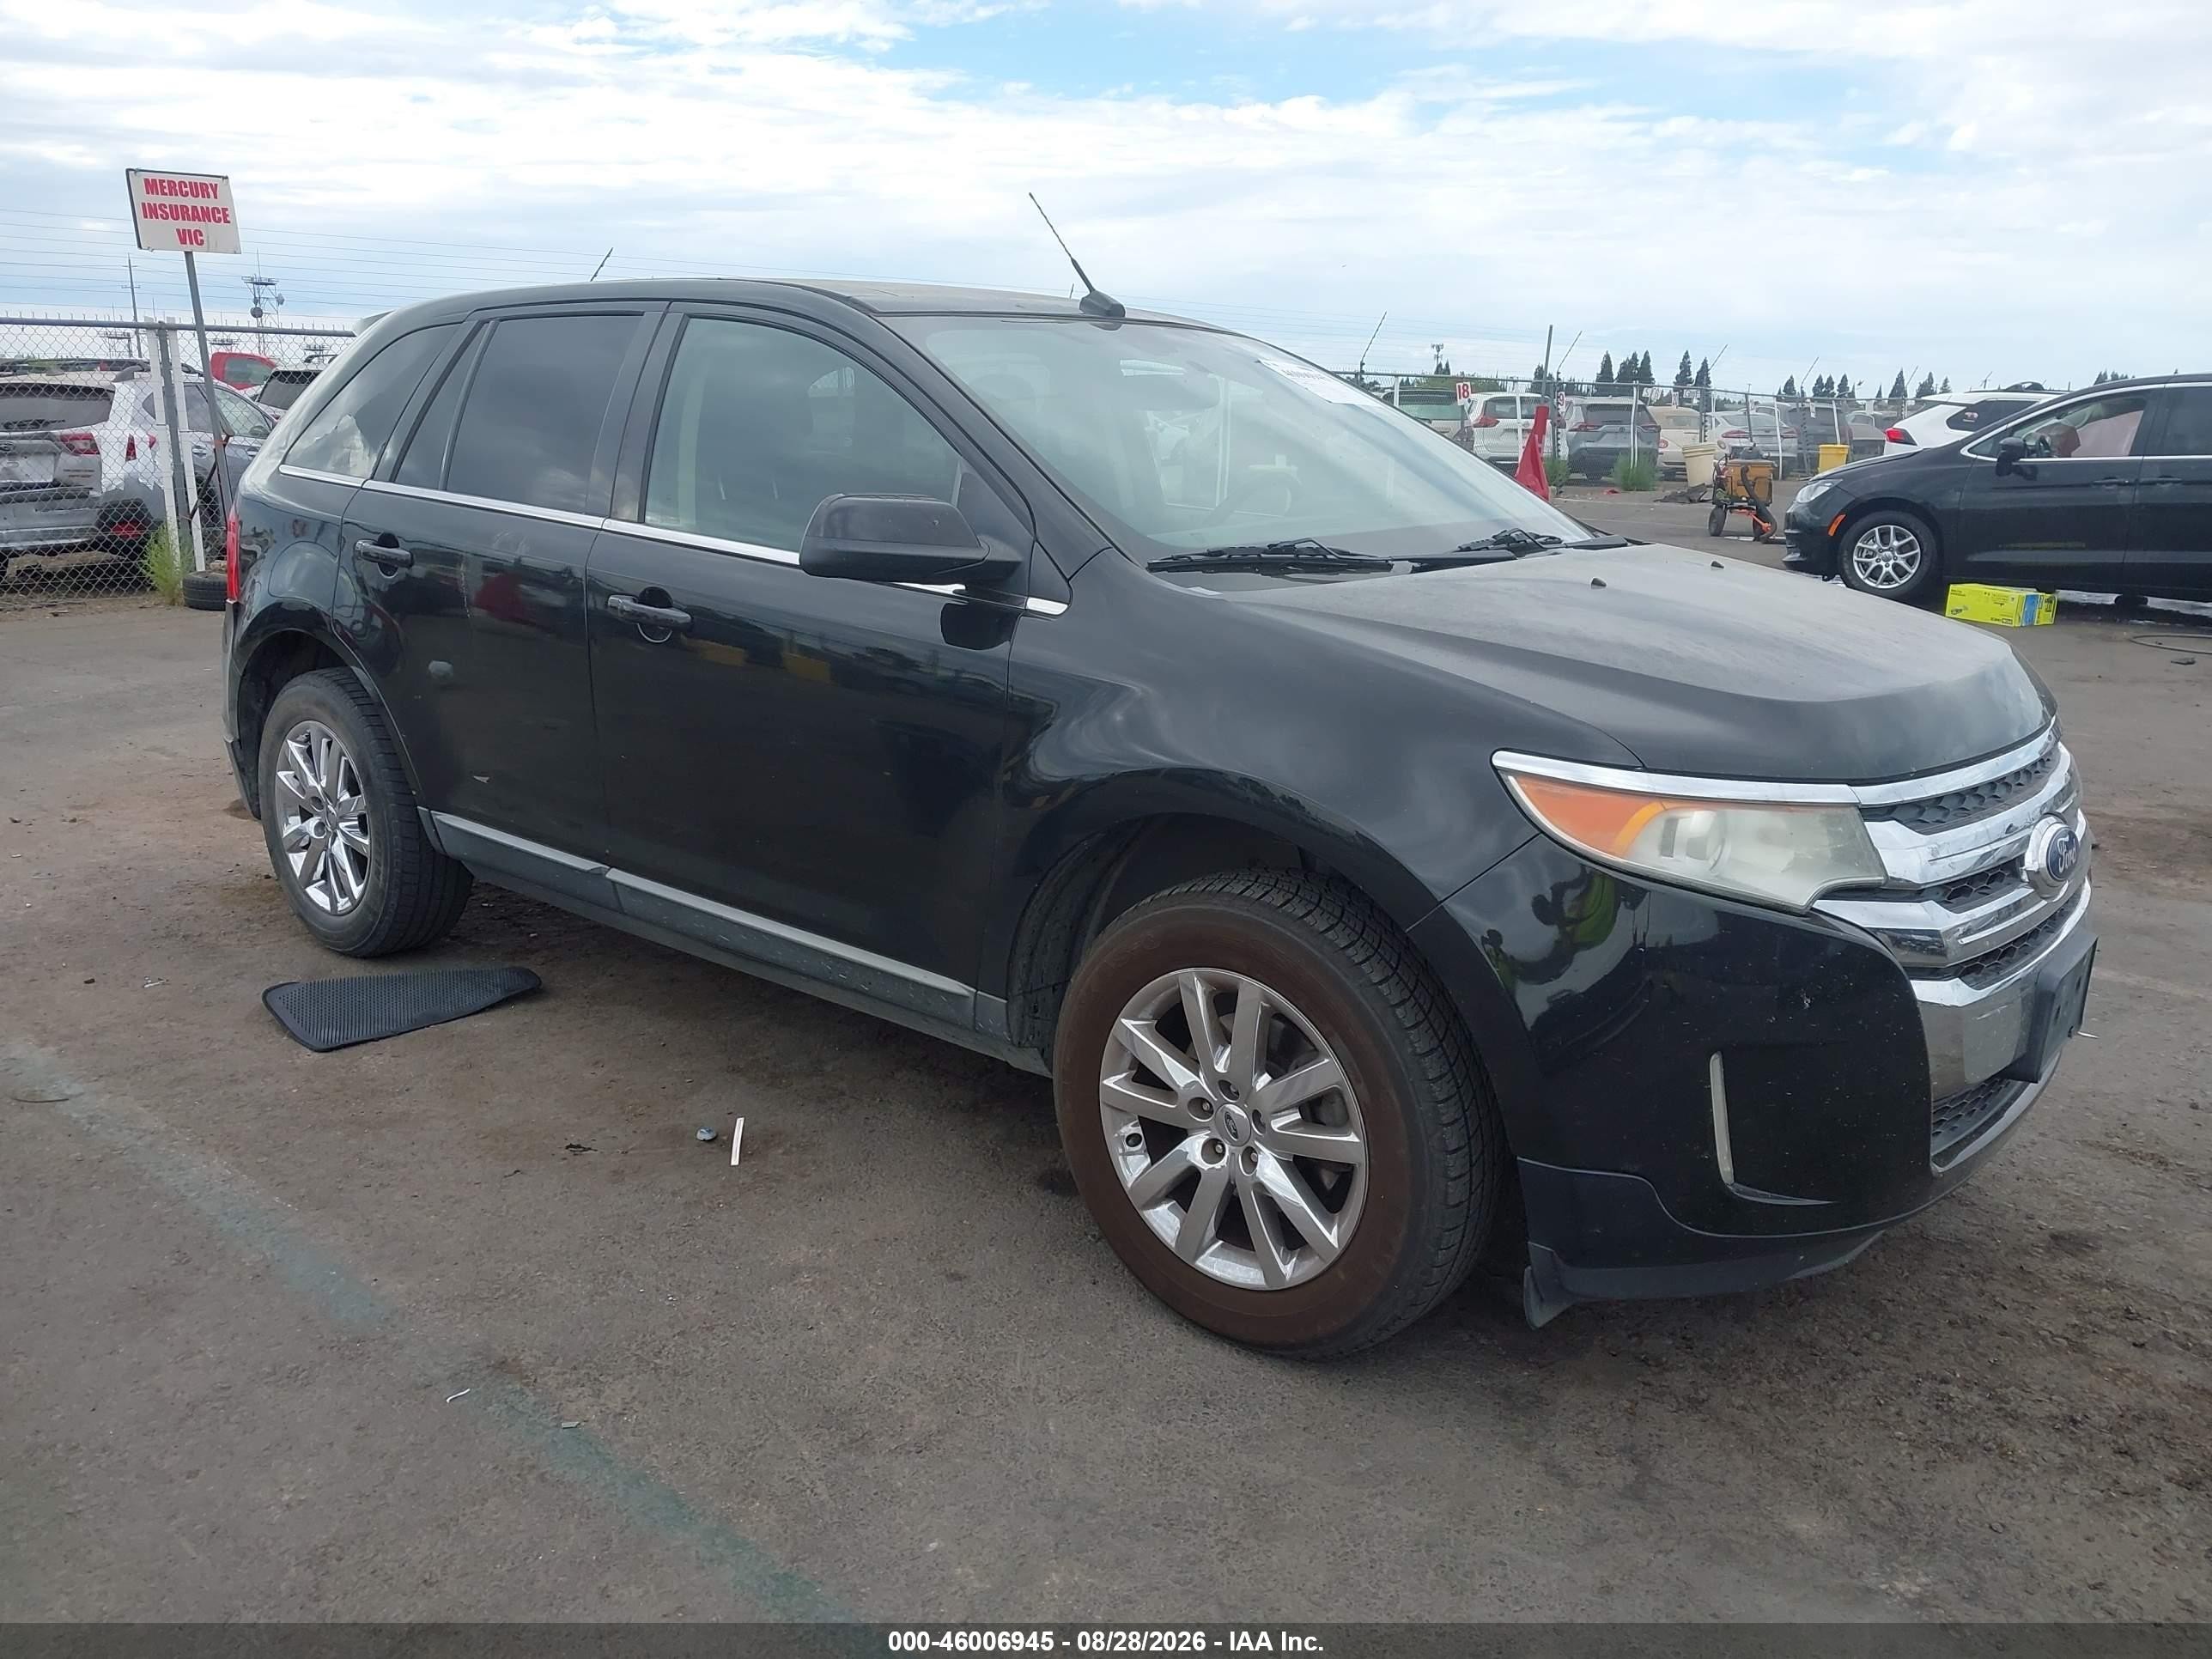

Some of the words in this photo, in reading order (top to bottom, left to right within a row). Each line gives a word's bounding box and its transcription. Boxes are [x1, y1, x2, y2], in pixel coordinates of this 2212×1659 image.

[143, 178, 218, 199] MERCURY
[141, 202, 231, 224] INSURANCE
[176, 228, 204, 246] VIC
[1457, 383, 1470, 400] 18
[2057, 834, 2076, 873] Ford
